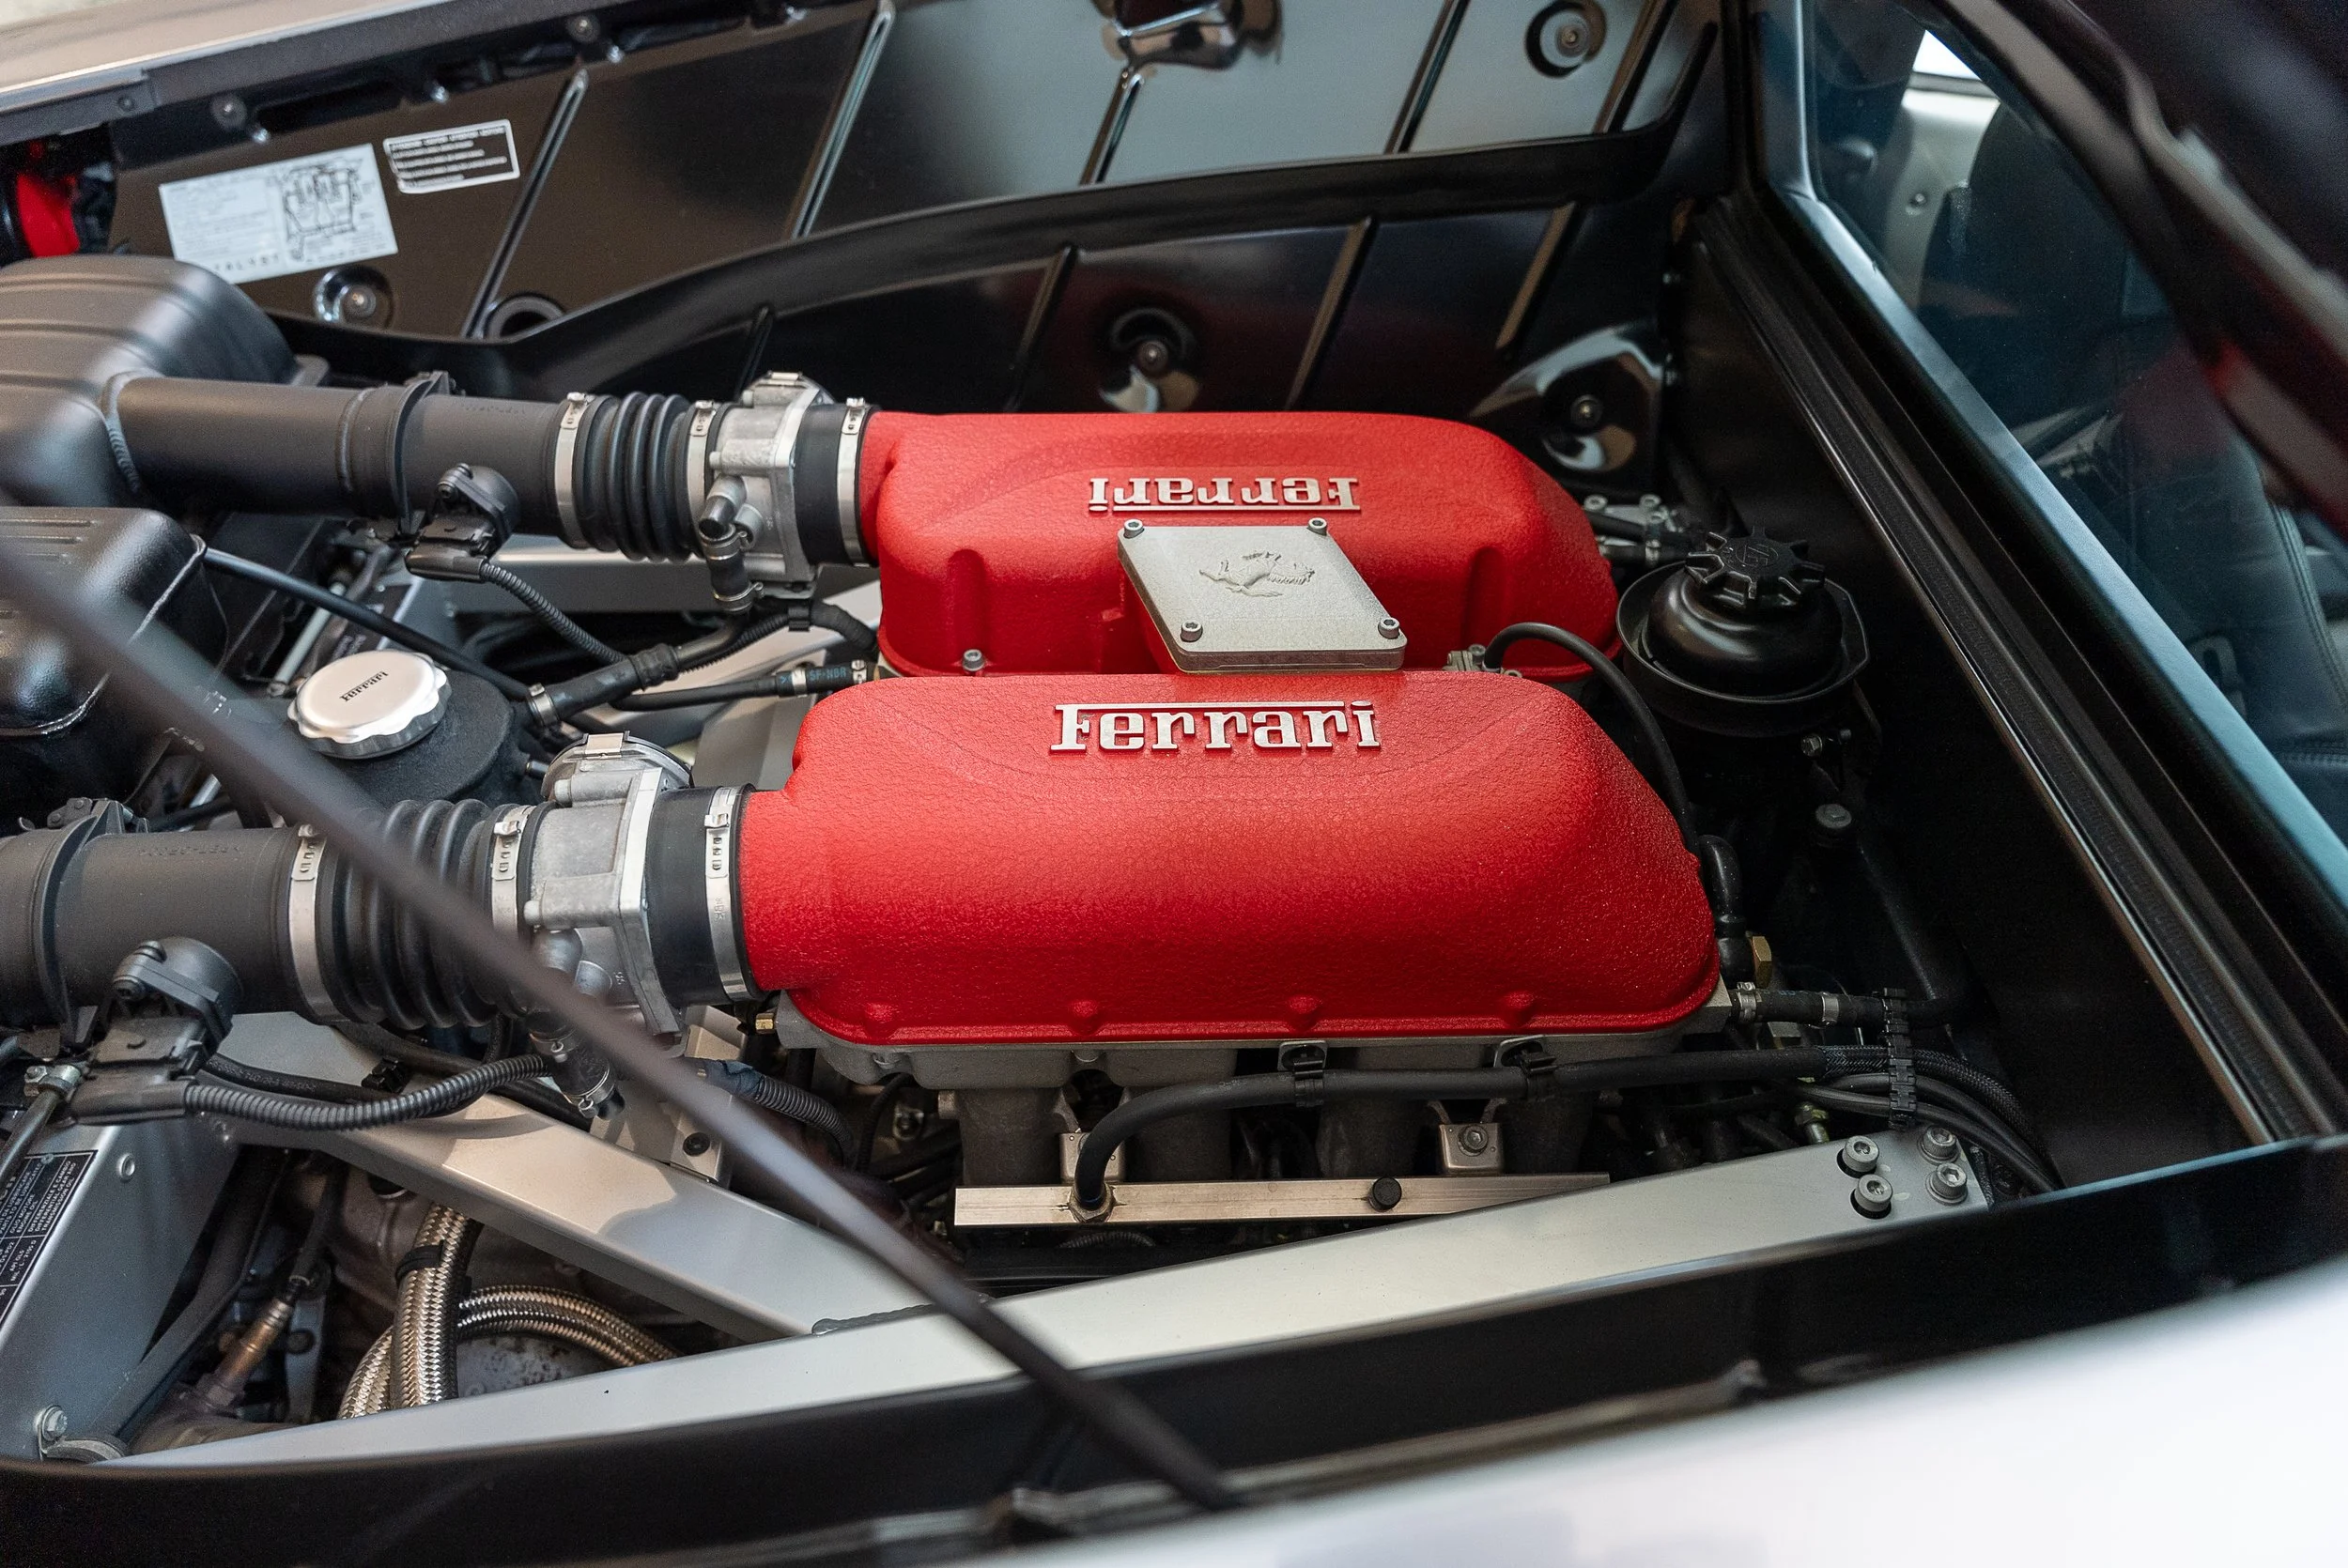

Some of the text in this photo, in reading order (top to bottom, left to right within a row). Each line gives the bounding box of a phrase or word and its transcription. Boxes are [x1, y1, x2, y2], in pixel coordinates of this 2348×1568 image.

[1089, 477, 1361, 512] Ferrari
[339, 670, 389, 702] Ferrari
[1050, 701, 1381, 752] Ferrari
[9, 1207, 17, 1215] TO
[10, 1193, 35, 1233] OLIO MOTORE
[17, 1200, 39, 1232] ENGINE OIL
[28, 1190, 54, 1232] DIFFERENZIALE
[56, 1161, 71, 1182] CAMBIO
[36, 1163, 76, 1231] DIFFERENTIAL GEAR AND
[42, 1177, 75, 1231] TRANSMISSION OIL
